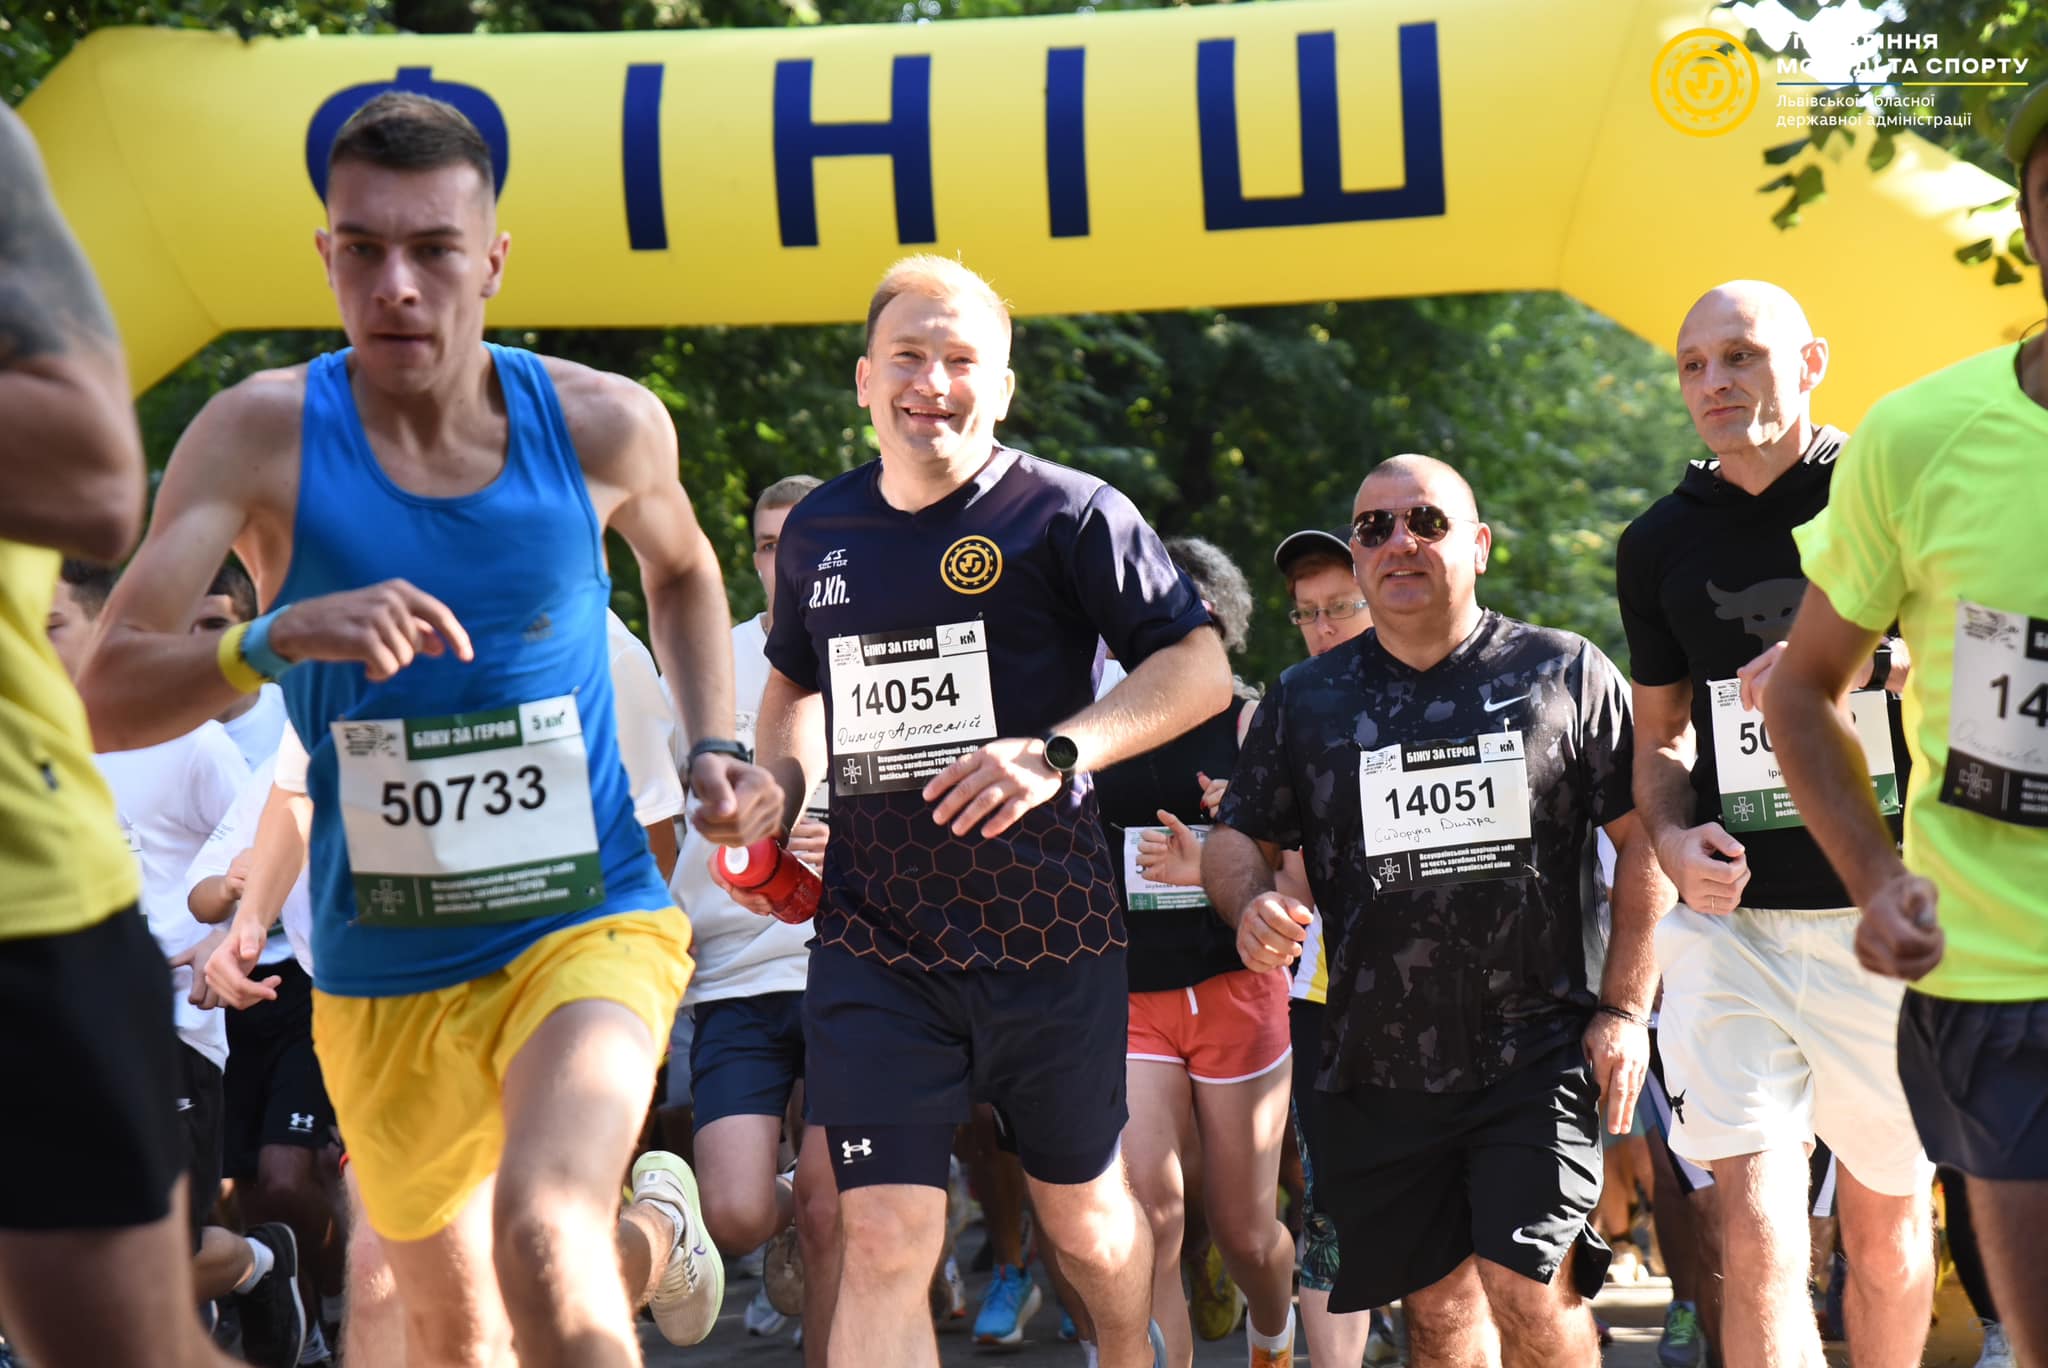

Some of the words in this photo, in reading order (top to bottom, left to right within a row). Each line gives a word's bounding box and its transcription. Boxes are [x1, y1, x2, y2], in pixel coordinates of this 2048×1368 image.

[864, 642, 887, 658] БІЖУ
[888, 640, 902, 655] ЗА
[902, 637, 934, 653] ГЕРОЯ
[851, 672, 960, 717] 14054
[1406, 749, 1431, 763] БІЖУ
[1432, 748, 1445, 760] ЗА
[1446, 745, 1476, 759] ГЕРОЯ
[381, 764, 547, 827] 50733
[1385, 776, 1495, 820] 14051
